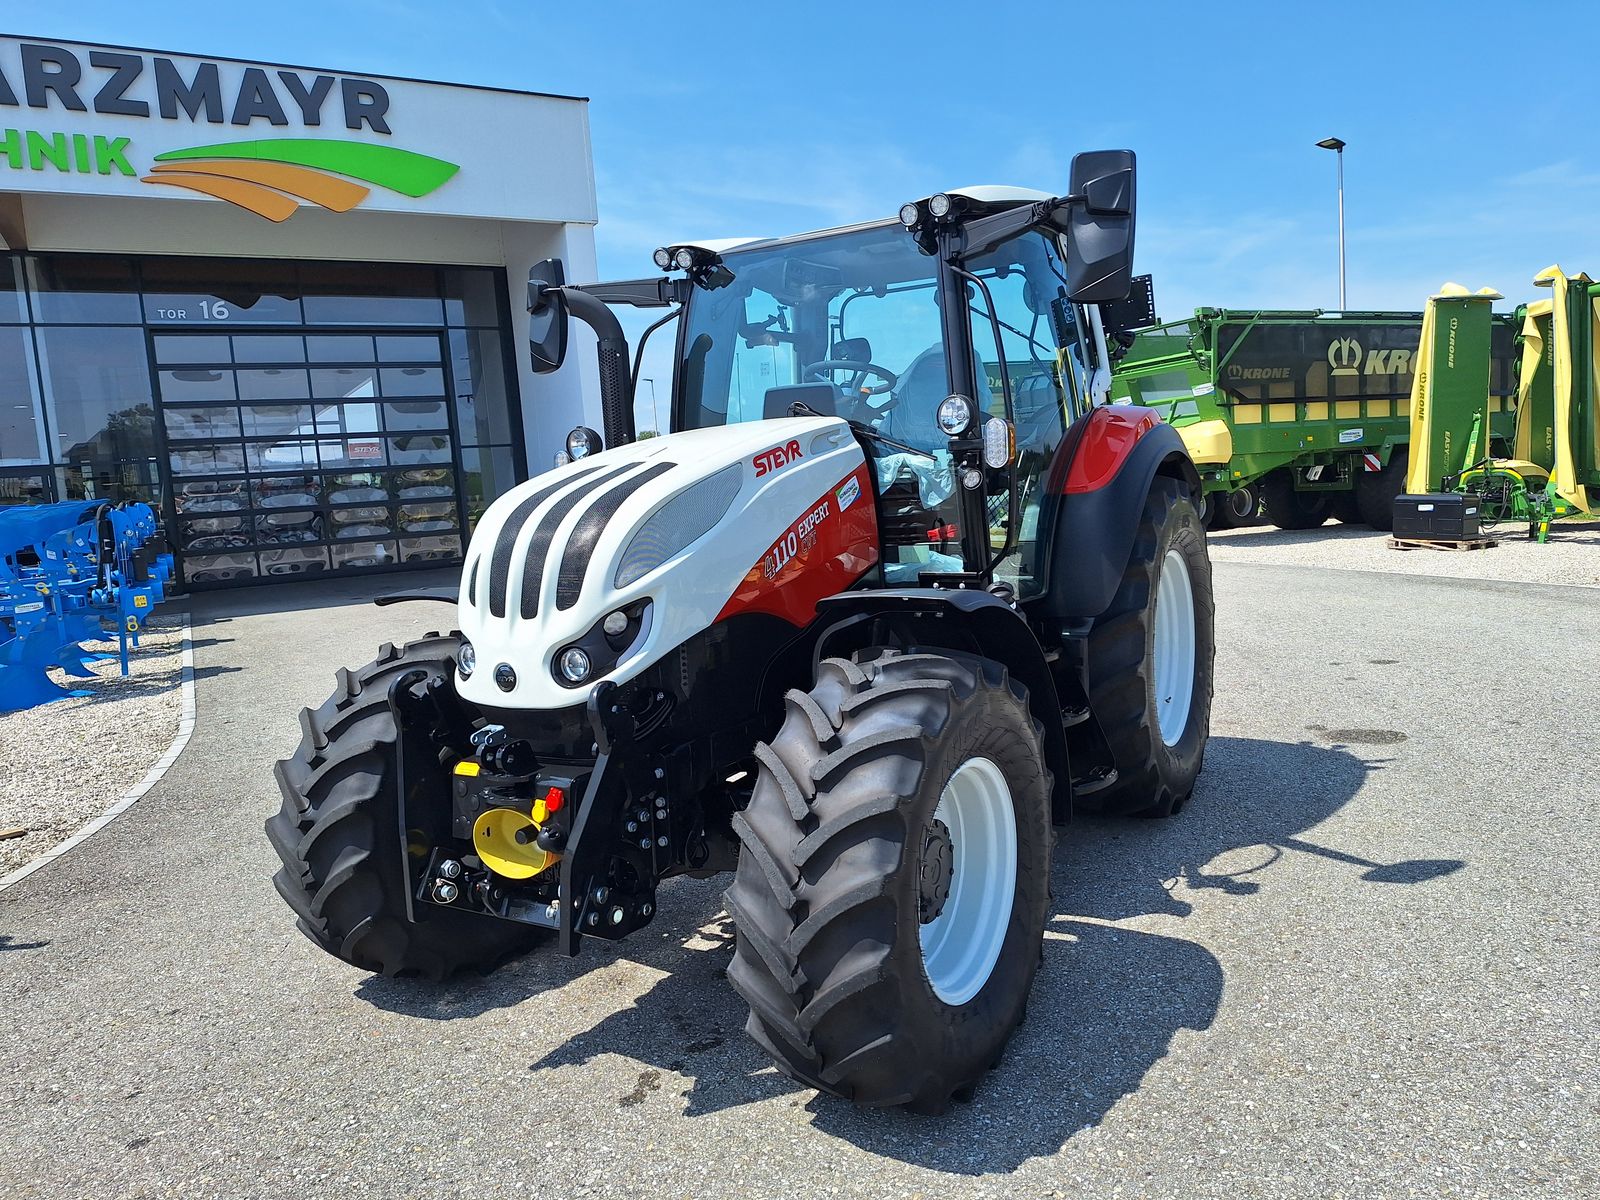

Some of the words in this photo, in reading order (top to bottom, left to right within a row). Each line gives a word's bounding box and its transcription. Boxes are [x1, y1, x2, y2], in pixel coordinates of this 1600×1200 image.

[157, 309, 187, 319] TOR
[199, 300, 229, 320] 16
[1448, 329, 1456, 369] KRONE
[1242, 367, 1291, 380] KRONE
[752, 439, 803, 478] STEYR
[764, 531, 798, 580] 4110
[798, 501, 830, 539] EXPERT
